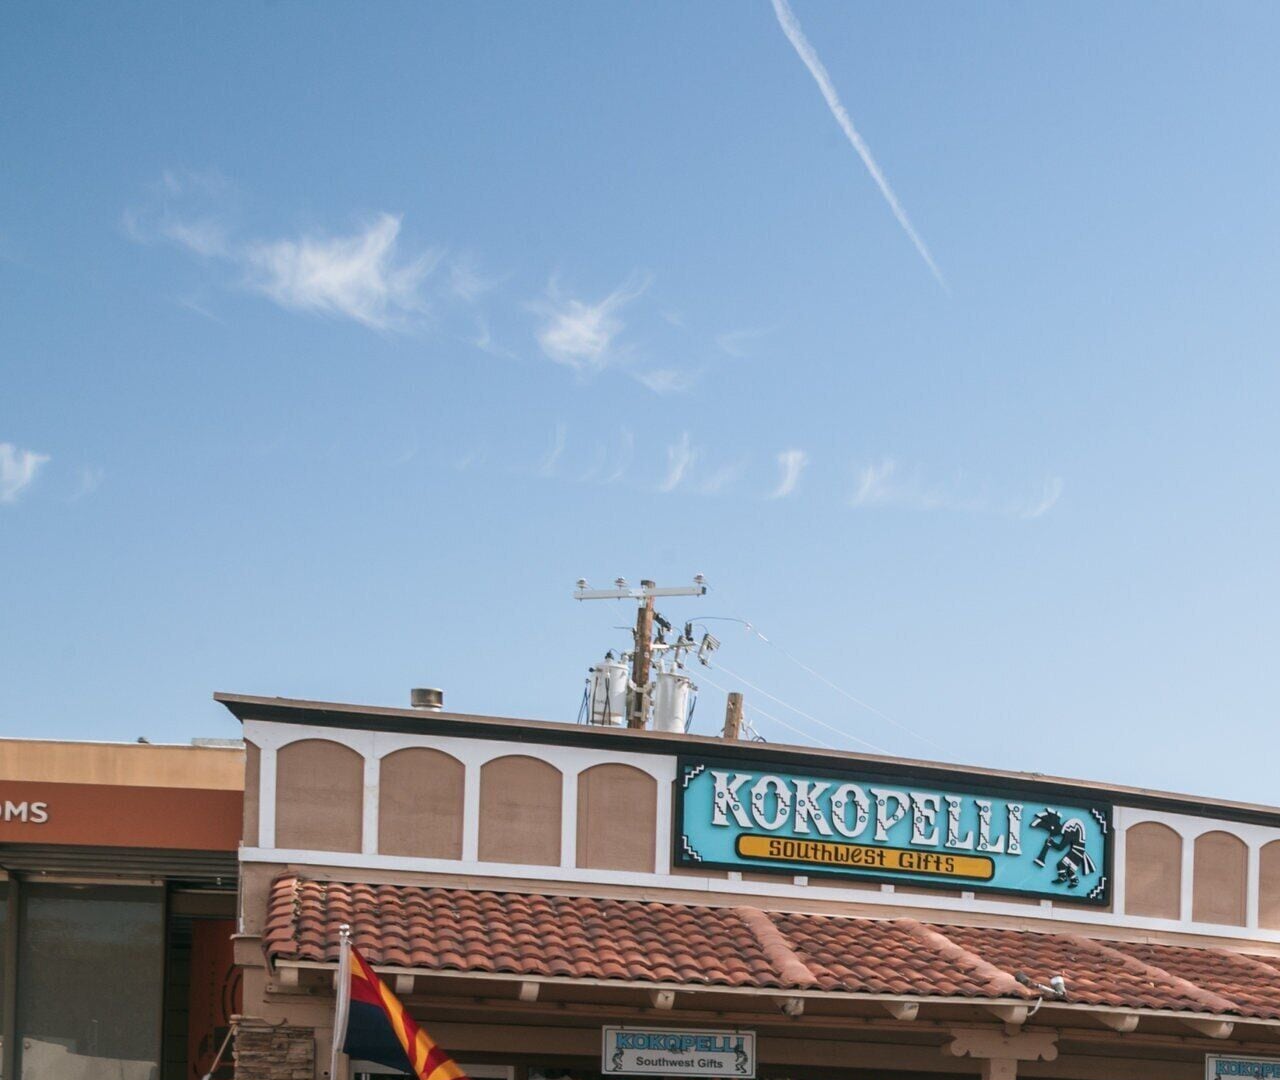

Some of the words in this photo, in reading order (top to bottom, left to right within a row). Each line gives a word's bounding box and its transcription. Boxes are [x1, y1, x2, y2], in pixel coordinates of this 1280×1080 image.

[0, 800, 48, 823] MS
[709, 770, 1024, 857] KOKOPELLI
[615, 1031, 745, 1054] KOKOPELLI
[635, 1056, 695, 1068] Southwest
[697, 1058, 724, 1069] Gifts
